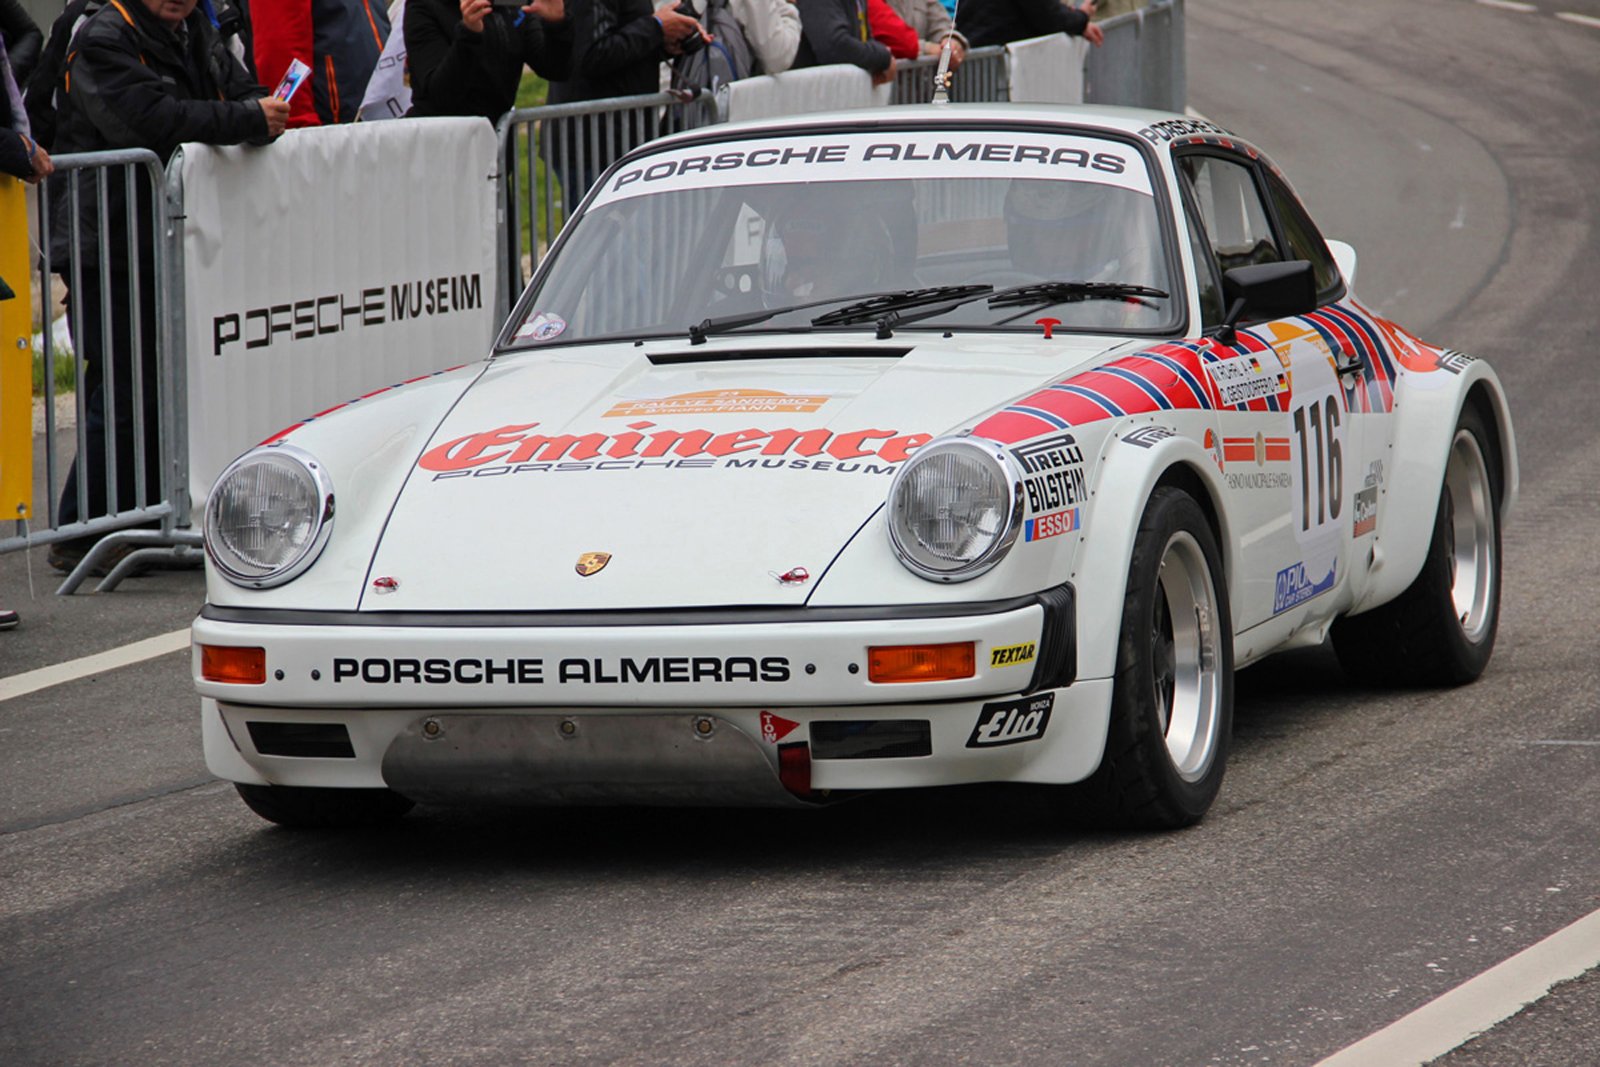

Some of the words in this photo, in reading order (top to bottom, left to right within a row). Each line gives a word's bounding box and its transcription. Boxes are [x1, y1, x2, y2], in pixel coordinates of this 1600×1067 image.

[613, 145, 850, 192] PORSCHE
[863, 143, 1126, 174] ALMERAS
[214, 288, 385, 356] PORSCHE
[632, 399, 706, 409] RALLYE
[713, 398, 809, 406] SANREMO
[418, 421, 934, 472] Eminence
[1009, 433, 1084, 474] PIRELLI
[1293, 395, 1343, 531] 116
[432, 459, 717, 482] PORSCHE
[725, 458, 897, 475] MUSEUM
[1024, 467, 1088, 514] BILSTEIN
[1039, 511, 1071, 538] ESSO
[333, 658, 544, 684] PORSCHE
[559, 657, 791, 683] ALMERAS
[991, 643, 1035, 666] TEXTAR
[763, 714, 777, 742] TOW
